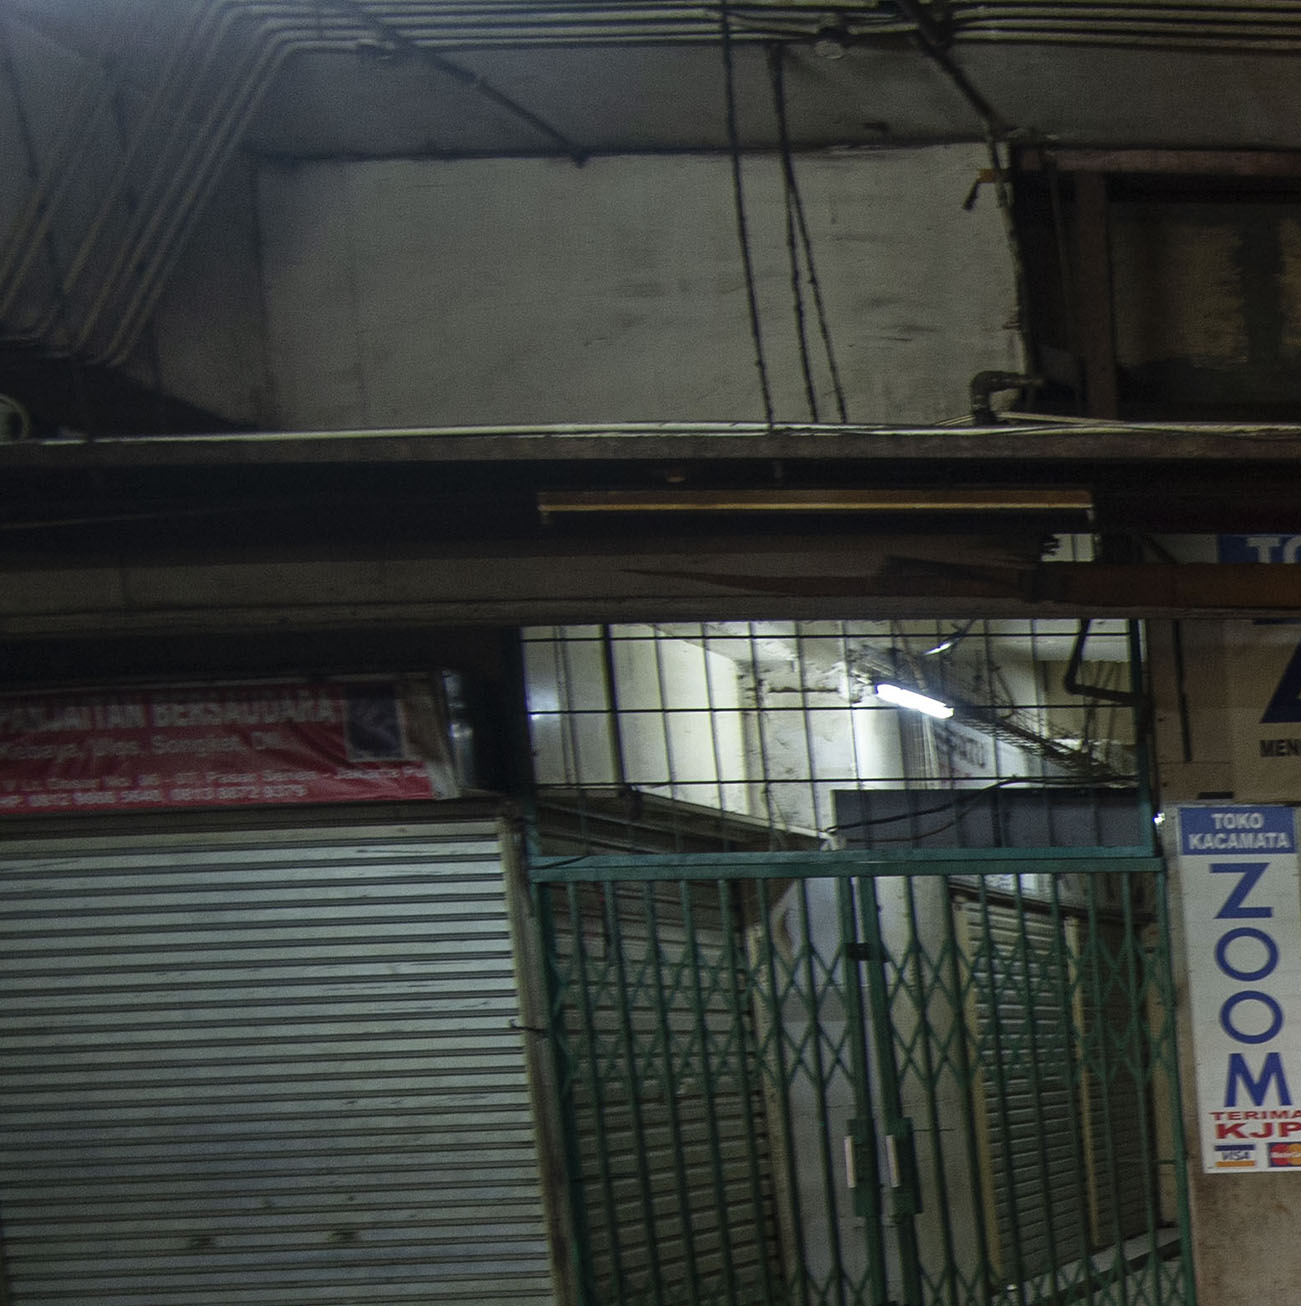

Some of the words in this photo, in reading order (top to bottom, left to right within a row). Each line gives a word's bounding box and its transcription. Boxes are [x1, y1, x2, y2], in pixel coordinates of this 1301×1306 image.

[1211, 812, 1265, 830] TOKO
[1187, 831, 1292, 851] KACAMATA
[1209, 862, 1294, 1107] ZOOM
